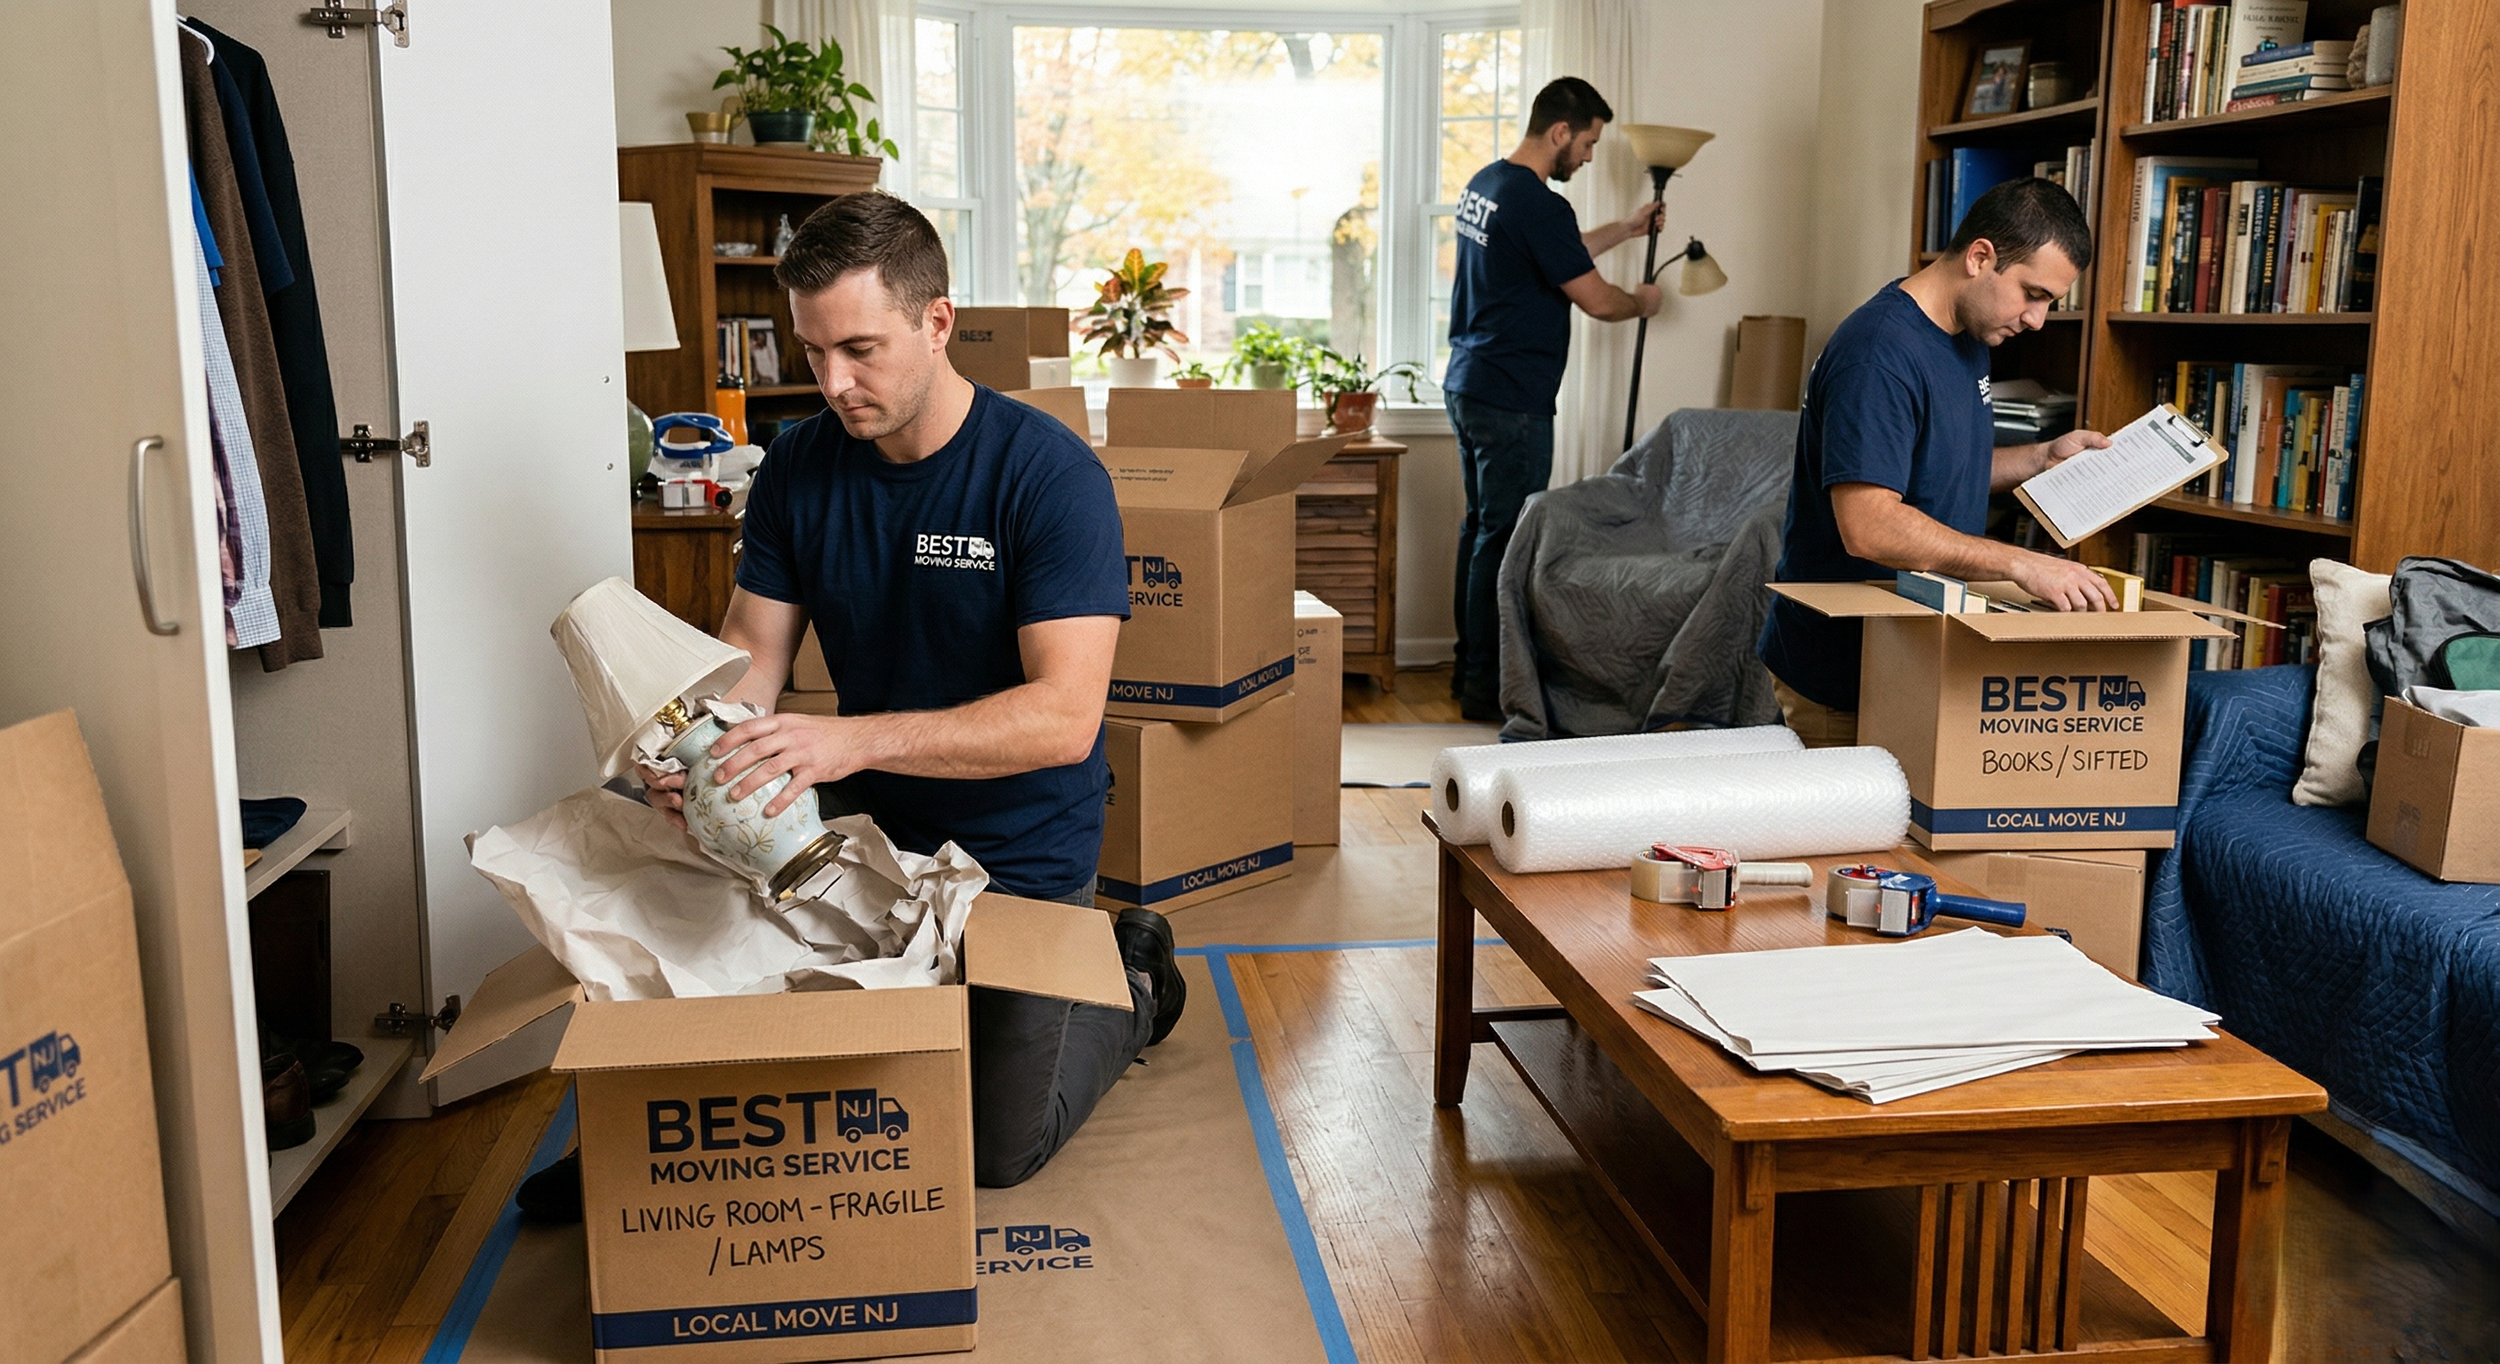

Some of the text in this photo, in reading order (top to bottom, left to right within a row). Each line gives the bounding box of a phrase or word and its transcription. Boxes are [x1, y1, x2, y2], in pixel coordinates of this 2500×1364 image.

[916, 533, 968, 556] BEST
[954, 558, 996, 571] SERVICE
[1145, 561, 1162, 574] NJ
[1112, 684, 1174, 701] MOVE NJ
[1981, 676, 2124, 712] BEST NJ
[1980, 716, 2145, 734] MOVING SERVICE
[1987, 811, 2126, 828] LOCAL MOVE NJ
[1182, 869, 1216, 891] LOCAL
[15, 1077, 87, 1136] SERVICE
[646, 1091, 873, 1154] BEST NJ
[650, 1148, 911, 1185] MOVING SERVICE
[622, 1203, 717, 1233] LIVING
[726, 1197, 805, 1227] ROOM
[829, 1187, 946, 1221] FRAGILE
[1012, 1230, 1045, 1243] NJ
[673, 1302, 899, 1338] LOCAL MOVE NJ
